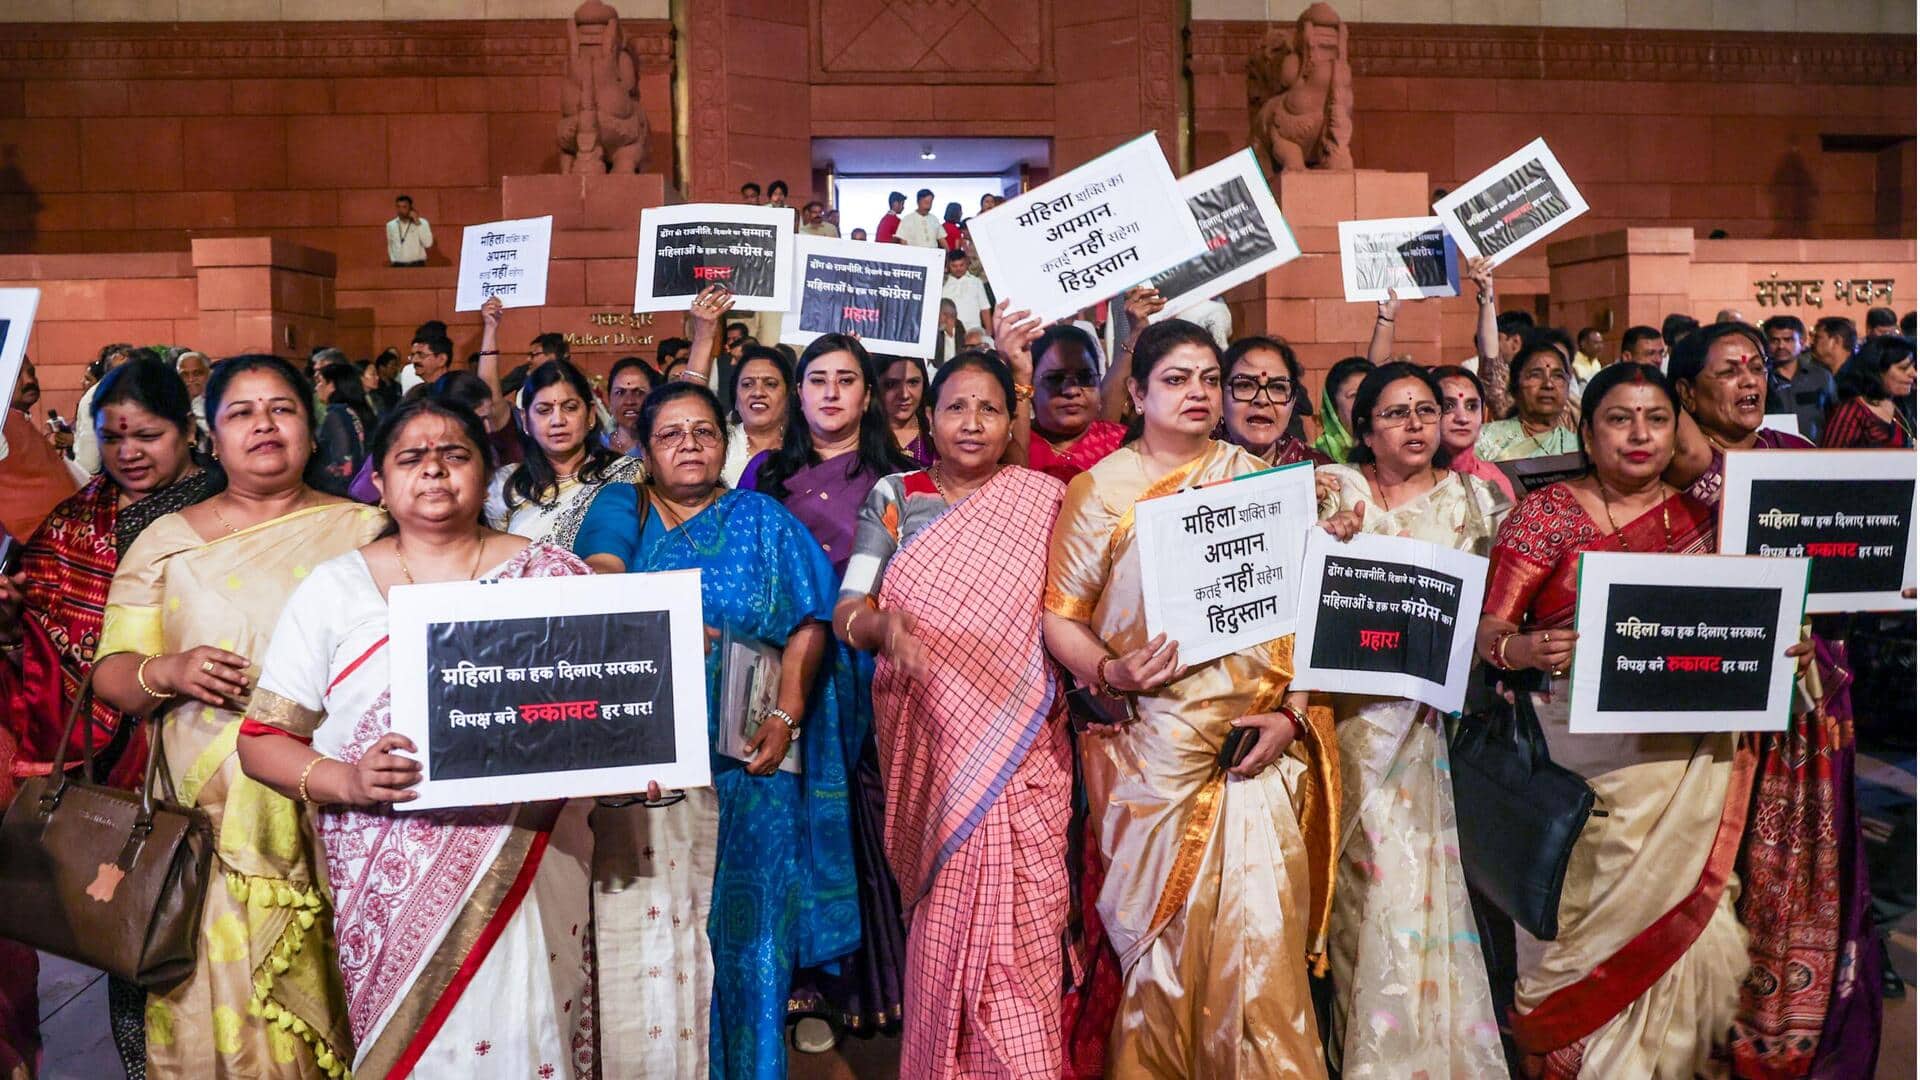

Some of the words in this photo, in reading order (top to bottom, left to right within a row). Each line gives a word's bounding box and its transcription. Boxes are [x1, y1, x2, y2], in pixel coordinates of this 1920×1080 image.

[1015, 192, 1075, 228] महिला
[1075, 181, 1107, 202] शक्ति
[1107, 173, 1124, 189] का
[481, 232, 505, 247] महिला
[658, 244, 696, 258] महिलाओं
[728, 243, 763, 258] कांग्रेस
[1040, 250, 1073, 274] कतई
[1068, 228, 1107, 259] नहीं
[1107, 221, 1140, 244] सहेगा
[492, 263, 509, 279] नहीं
[1057, 245, 1140, 293] हिंदुस्तान
[806, 278, 846, 293] महिलाओं
[878, 285, 912, 300] कांग्रेस
[1753, 271, 1825, 309] संसद
[1833, 278, 1896, 306] भवन
[563, 331, 610, 345] Makar
[614, 333, 654, 345] Dwar
[1182, 504, 1236, 535] महिला
[1238, 502, 1266, 523] शक्ति
[1267, 501, 1281, 516] का
[1758, 508, 1800, 530] महिला
[1800, 515, 1815, 528] का
[1815, 515, 1833, 529] हक
[1835, 511, 1865, 529] दिलाए
[1806, 542, 1859, 558] रुकावट
[1194, 577, 1222, 602] कतई
[1222, 562, 1255, 593] नहीं
[1256, 565, 1283, 586] सहेगा
[1327, 561, 1344, 578] ढोंग
[1206, 595, 1278, 634] हिंदुस्तान
[1322, 590, 1366, 610] महिलाओं
[1366, 594, 1375, 611] के
[1390, 602, 1401, 614] पर
[1400, 597, 1441, 623] कांग्रेस
[1441, 614, 1454, 627] का
[1360, 629, 1400, 651] प्रहार!
[1616, 616, 1660, 639] महिला
[1661, 626, 1676, 638] का
[1677, 626, 1695, 640] हक
[1697, 622, 1728, 641] दिलाए
[1729, 626, 1767, 640] सरकार,
[441, 660, 504, 688] महिला
[505, 666, 526, 682] का
[528, 666, 554, 684] हक
[557, 660, 602, 681] दिलाए
[604, 659, 658, 676] सरकार,
[1617, 655, 1647, 674] विपक्ष
[1648, 656, 1665, 672] बने
[1666, 656, 1723, 673] रुकावट
[1721, 661, 1736, 674] हर
[1737, 660, 1759, 673] बार!
[449, 709, 492, 730] विपक्ष
[494, 706, 518, 726] बने
[518, 700, 599, 724] रुकावट
[600, 703, 621, 721] हर
[623, 701, 654, 717] बार!
